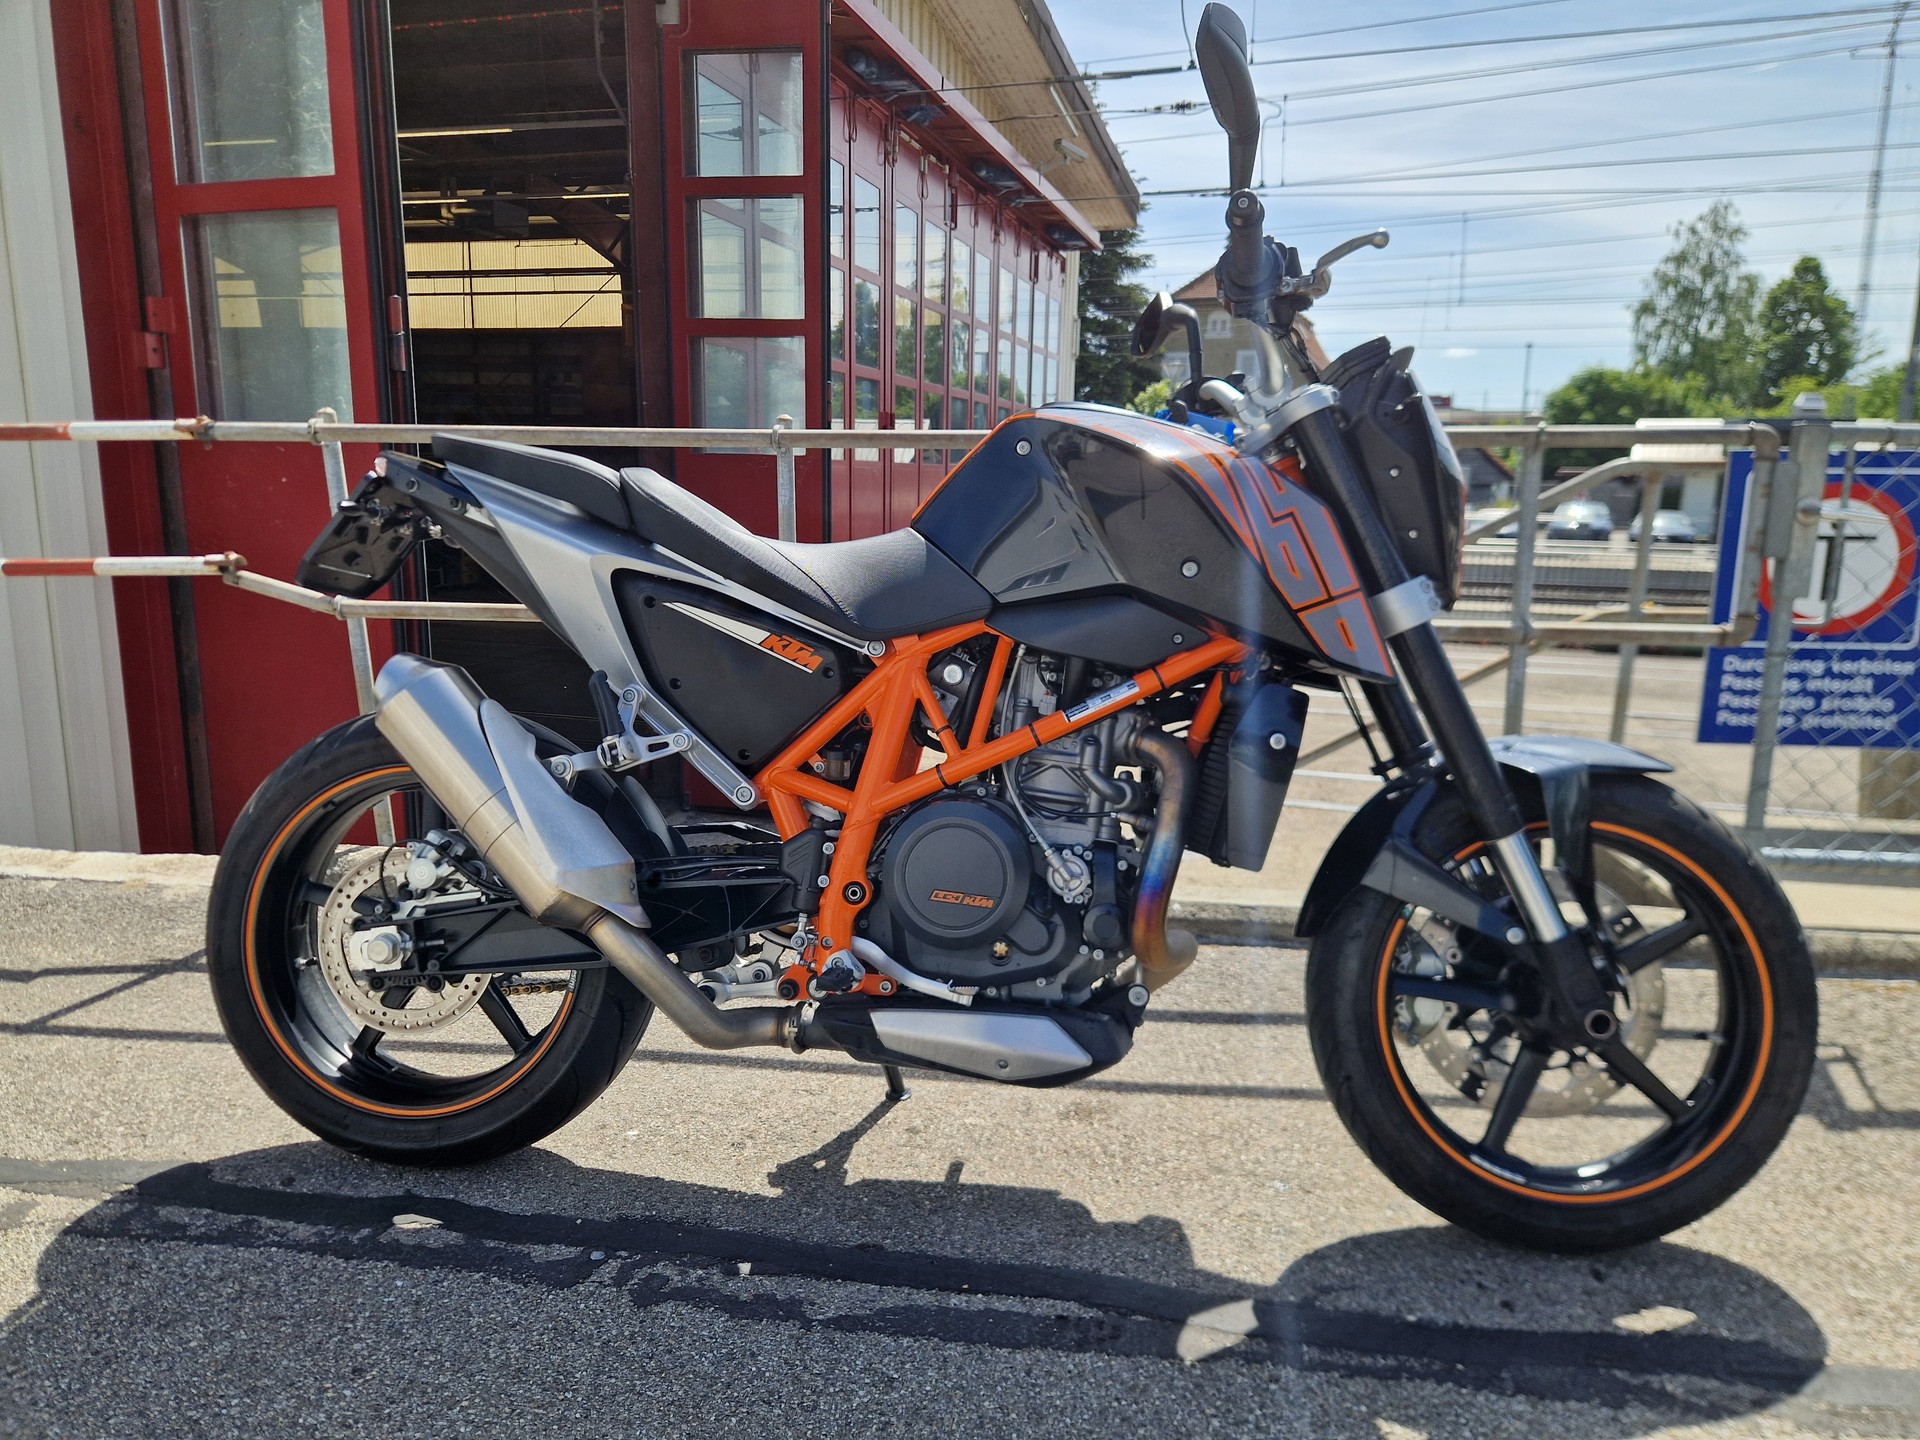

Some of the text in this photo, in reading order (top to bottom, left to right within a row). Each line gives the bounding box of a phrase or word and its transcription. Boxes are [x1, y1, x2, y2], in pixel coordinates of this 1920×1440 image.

[760, 634, 823, 671] KTM
[1831, 657, 1916, 675] verboten
[1806, 675, 1874, 694] interdit
[1820, 693, 1895, 713] proibito
[962, 895, 994, 908] KTM
